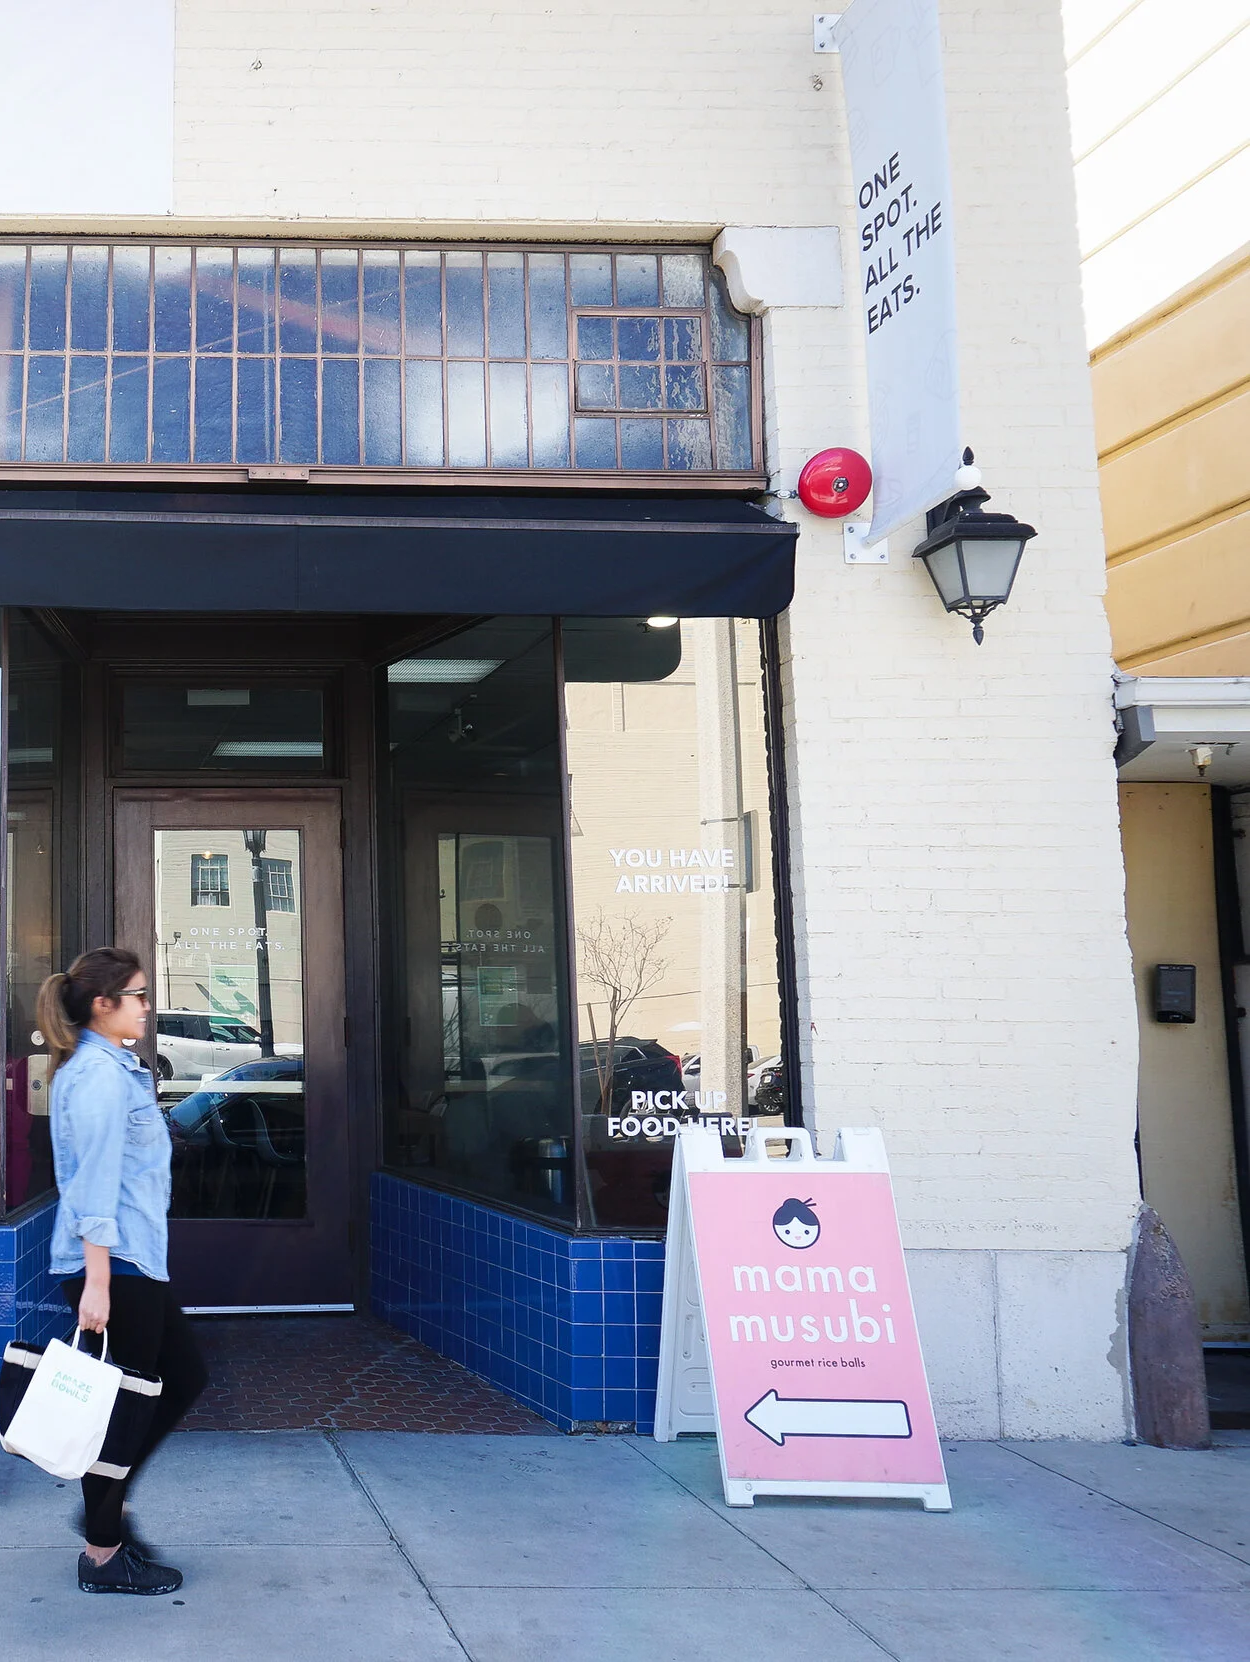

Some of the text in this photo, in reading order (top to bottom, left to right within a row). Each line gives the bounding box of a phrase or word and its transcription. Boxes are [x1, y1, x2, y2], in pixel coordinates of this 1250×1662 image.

[857, 151, 901, 211] ONE
[861, 183, 919, 253] SPOT.
[864, 200, 945, 295] ALL THE
[866, 273, 921, 337] EATS.
[609, 848, 735, 868] YOU HAVE
[615, 875, 730, 894] ARRIVED!
[190, 927, 268, 937] ONE SPOT.
[174, 940, 285, 951] ALL THE EATS.
[631, 1090, 727, 1111] PICK UP
[607, 1117, 681, 1137] FOOD
[732, 1264, 877, 1293] mama
[728, 1299, 897, 1344] musubi
[770, 1356, 866, 1370] gourmet rice balls
[54, 1370, 93, 1394] AMAZE
